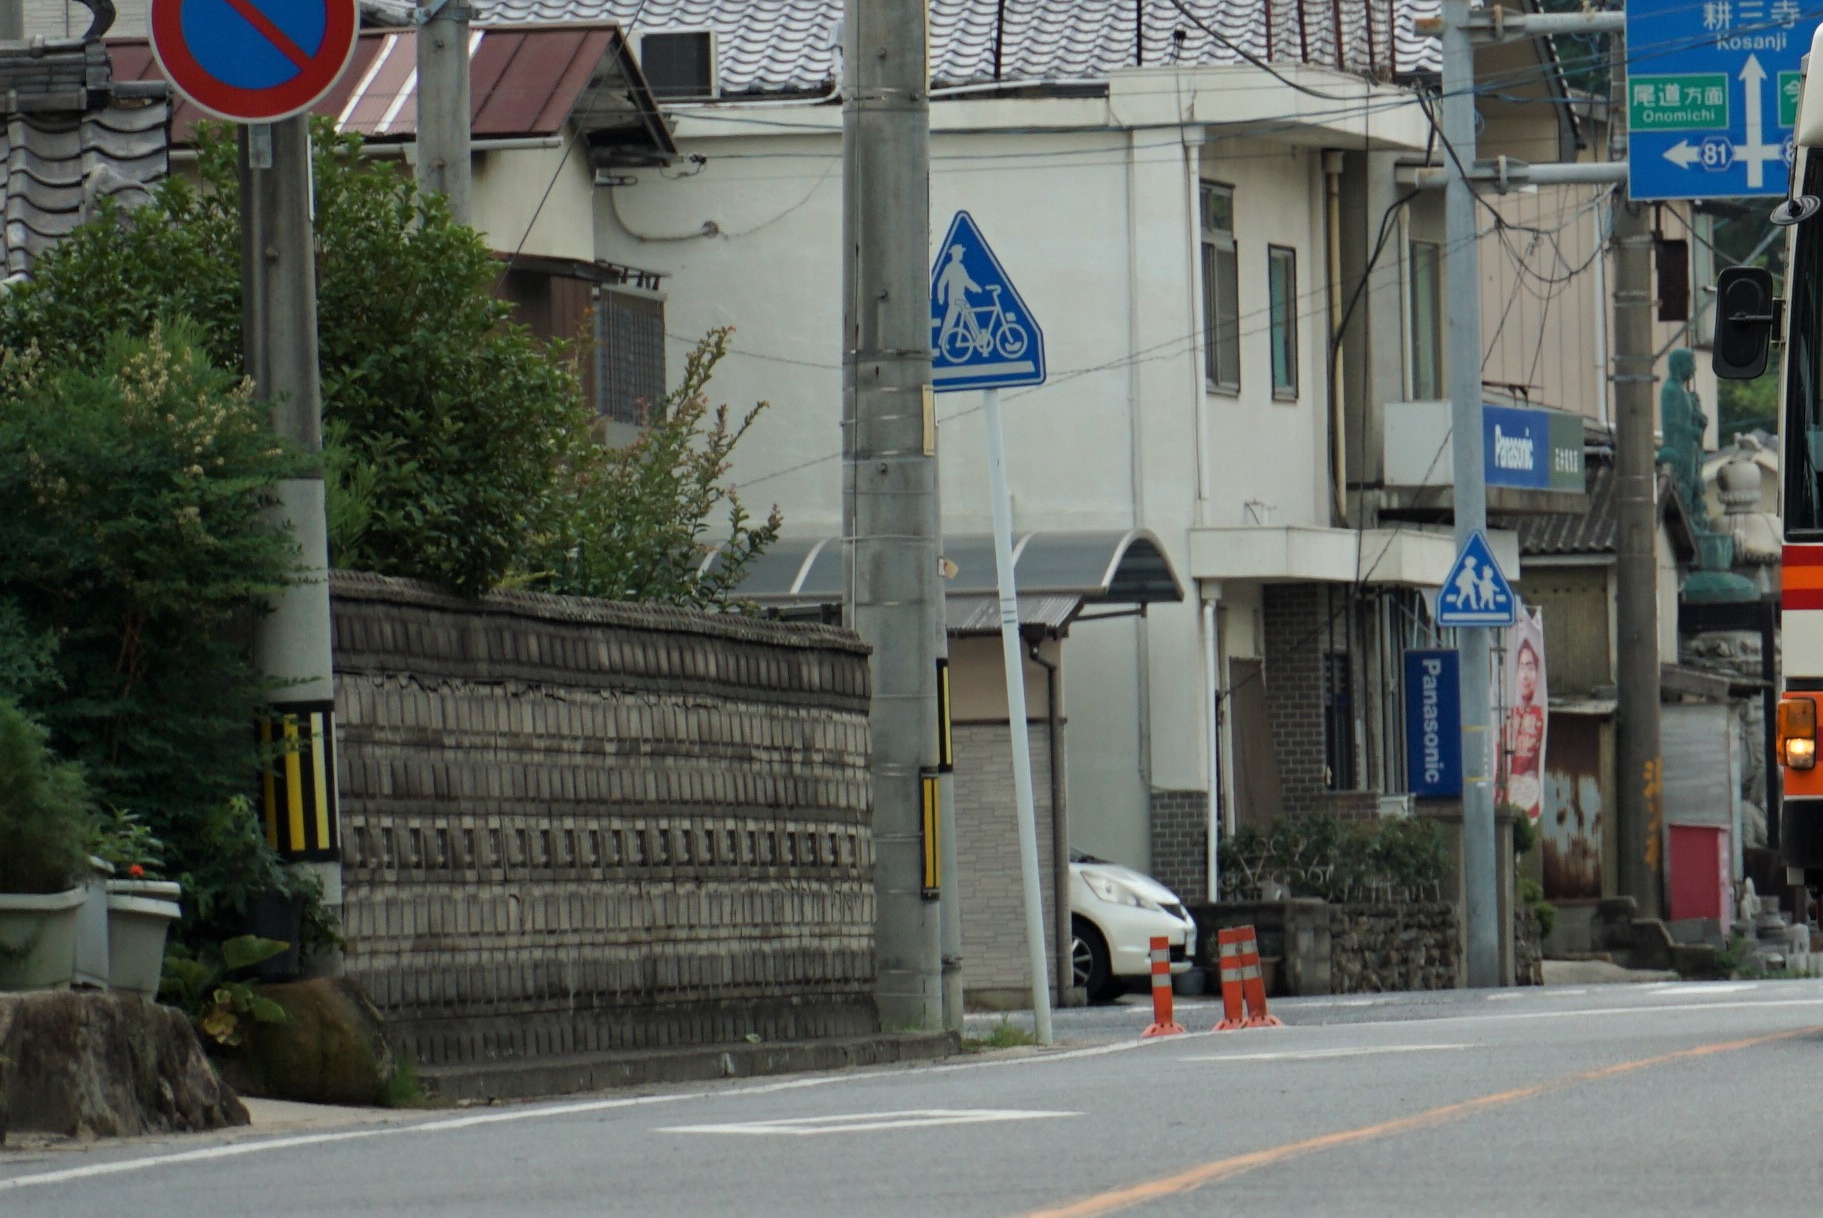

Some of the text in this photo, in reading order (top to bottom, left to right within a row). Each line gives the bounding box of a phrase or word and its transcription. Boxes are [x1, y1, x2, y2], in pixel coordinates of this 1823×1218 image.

[1703, 0, 1800, 30] 耕三寺
[1716, 33, 1787, 51] Kosanji
[1633, 83, 1723, 107] 尾道方面
[1642, 109, 1715, 123] Onomichi
[1703, 143, 1727, 165] 81
[1494, 424, 1534, 471] Panasonic
[1422, 658, 1445, 783] Panasonic
